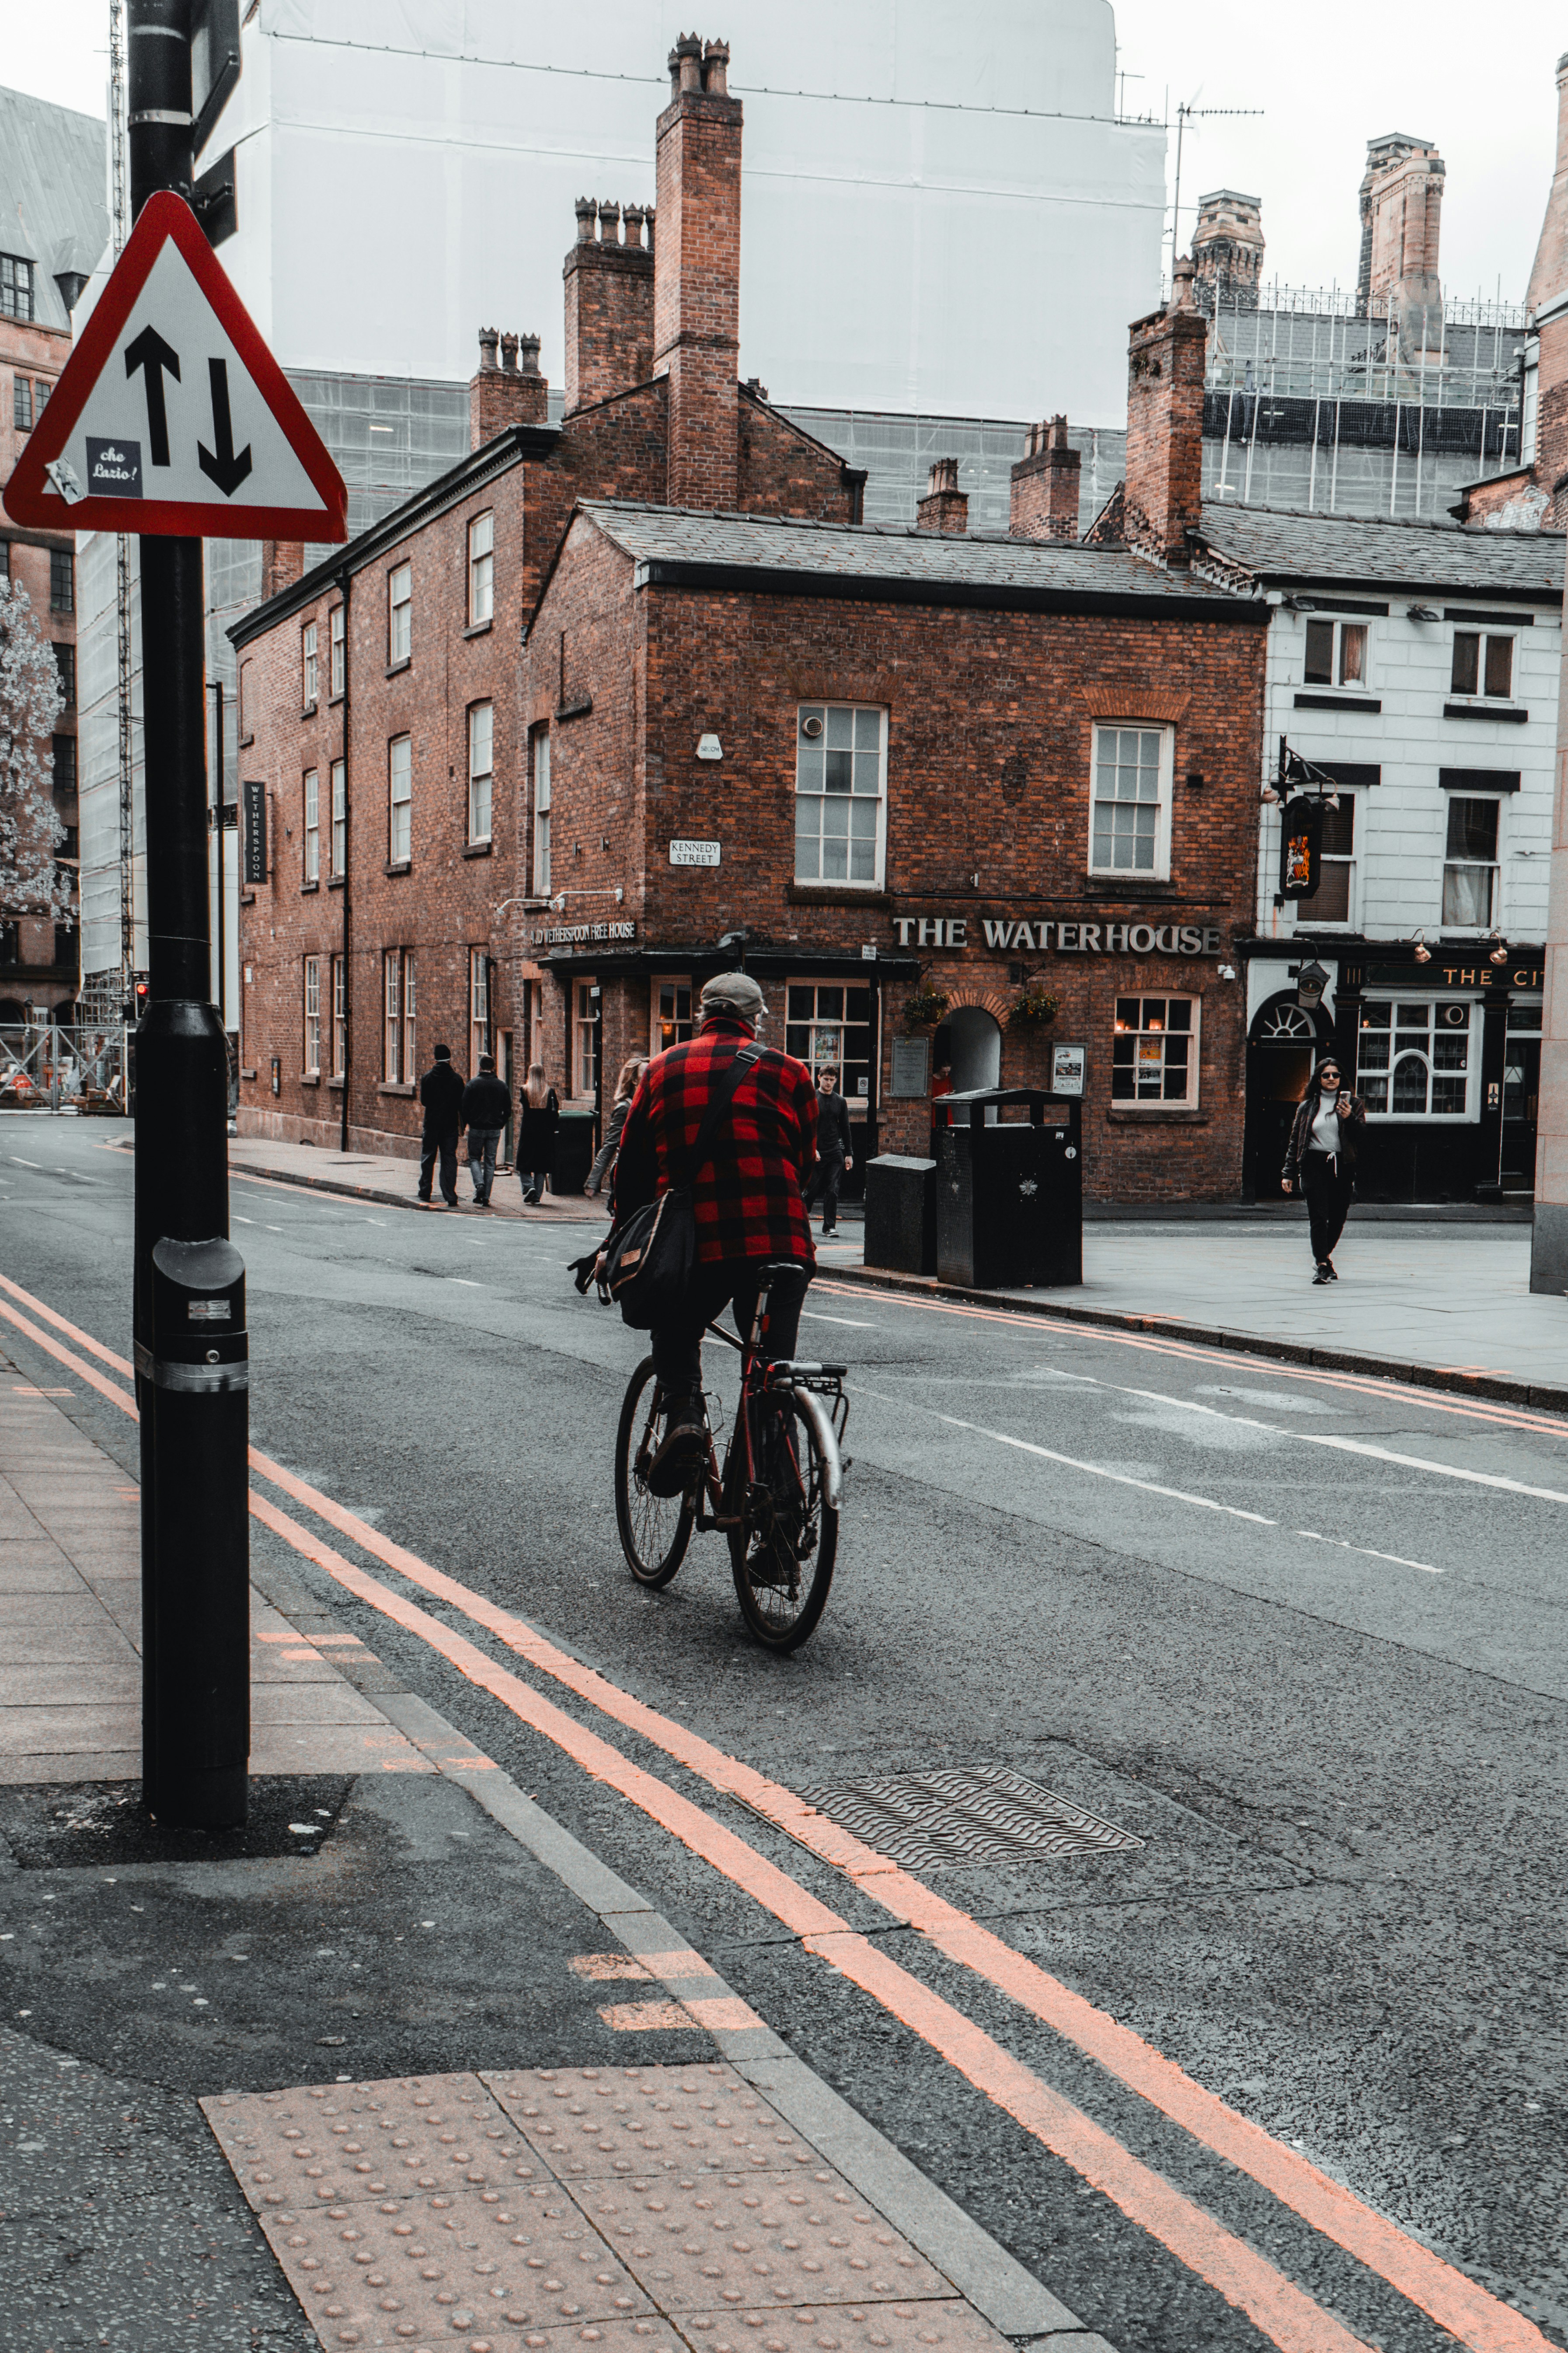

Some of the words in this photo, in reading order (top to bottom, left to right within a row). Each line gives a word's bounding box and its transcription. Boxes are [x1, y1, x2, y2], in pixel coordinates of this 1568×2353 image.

[100, 447, 126, 462] che
[93, 464, 137, 480] Lazio!
[251, 786, 260, 879] WETHERSPOON
[672, 843, 718, 853] KENNEDY
[677, 854, 713, 863] STREET
[544, 925, 589, 943] WETHERSPOON
[591, 924, 607, 940] FREE
[609, 922, 634, 938] HOUSE
[893, 918, 967, 947] THE
[983, 920, 1222, 954] WATERHOUSE
[1443, 969, 1492, 984] THE
